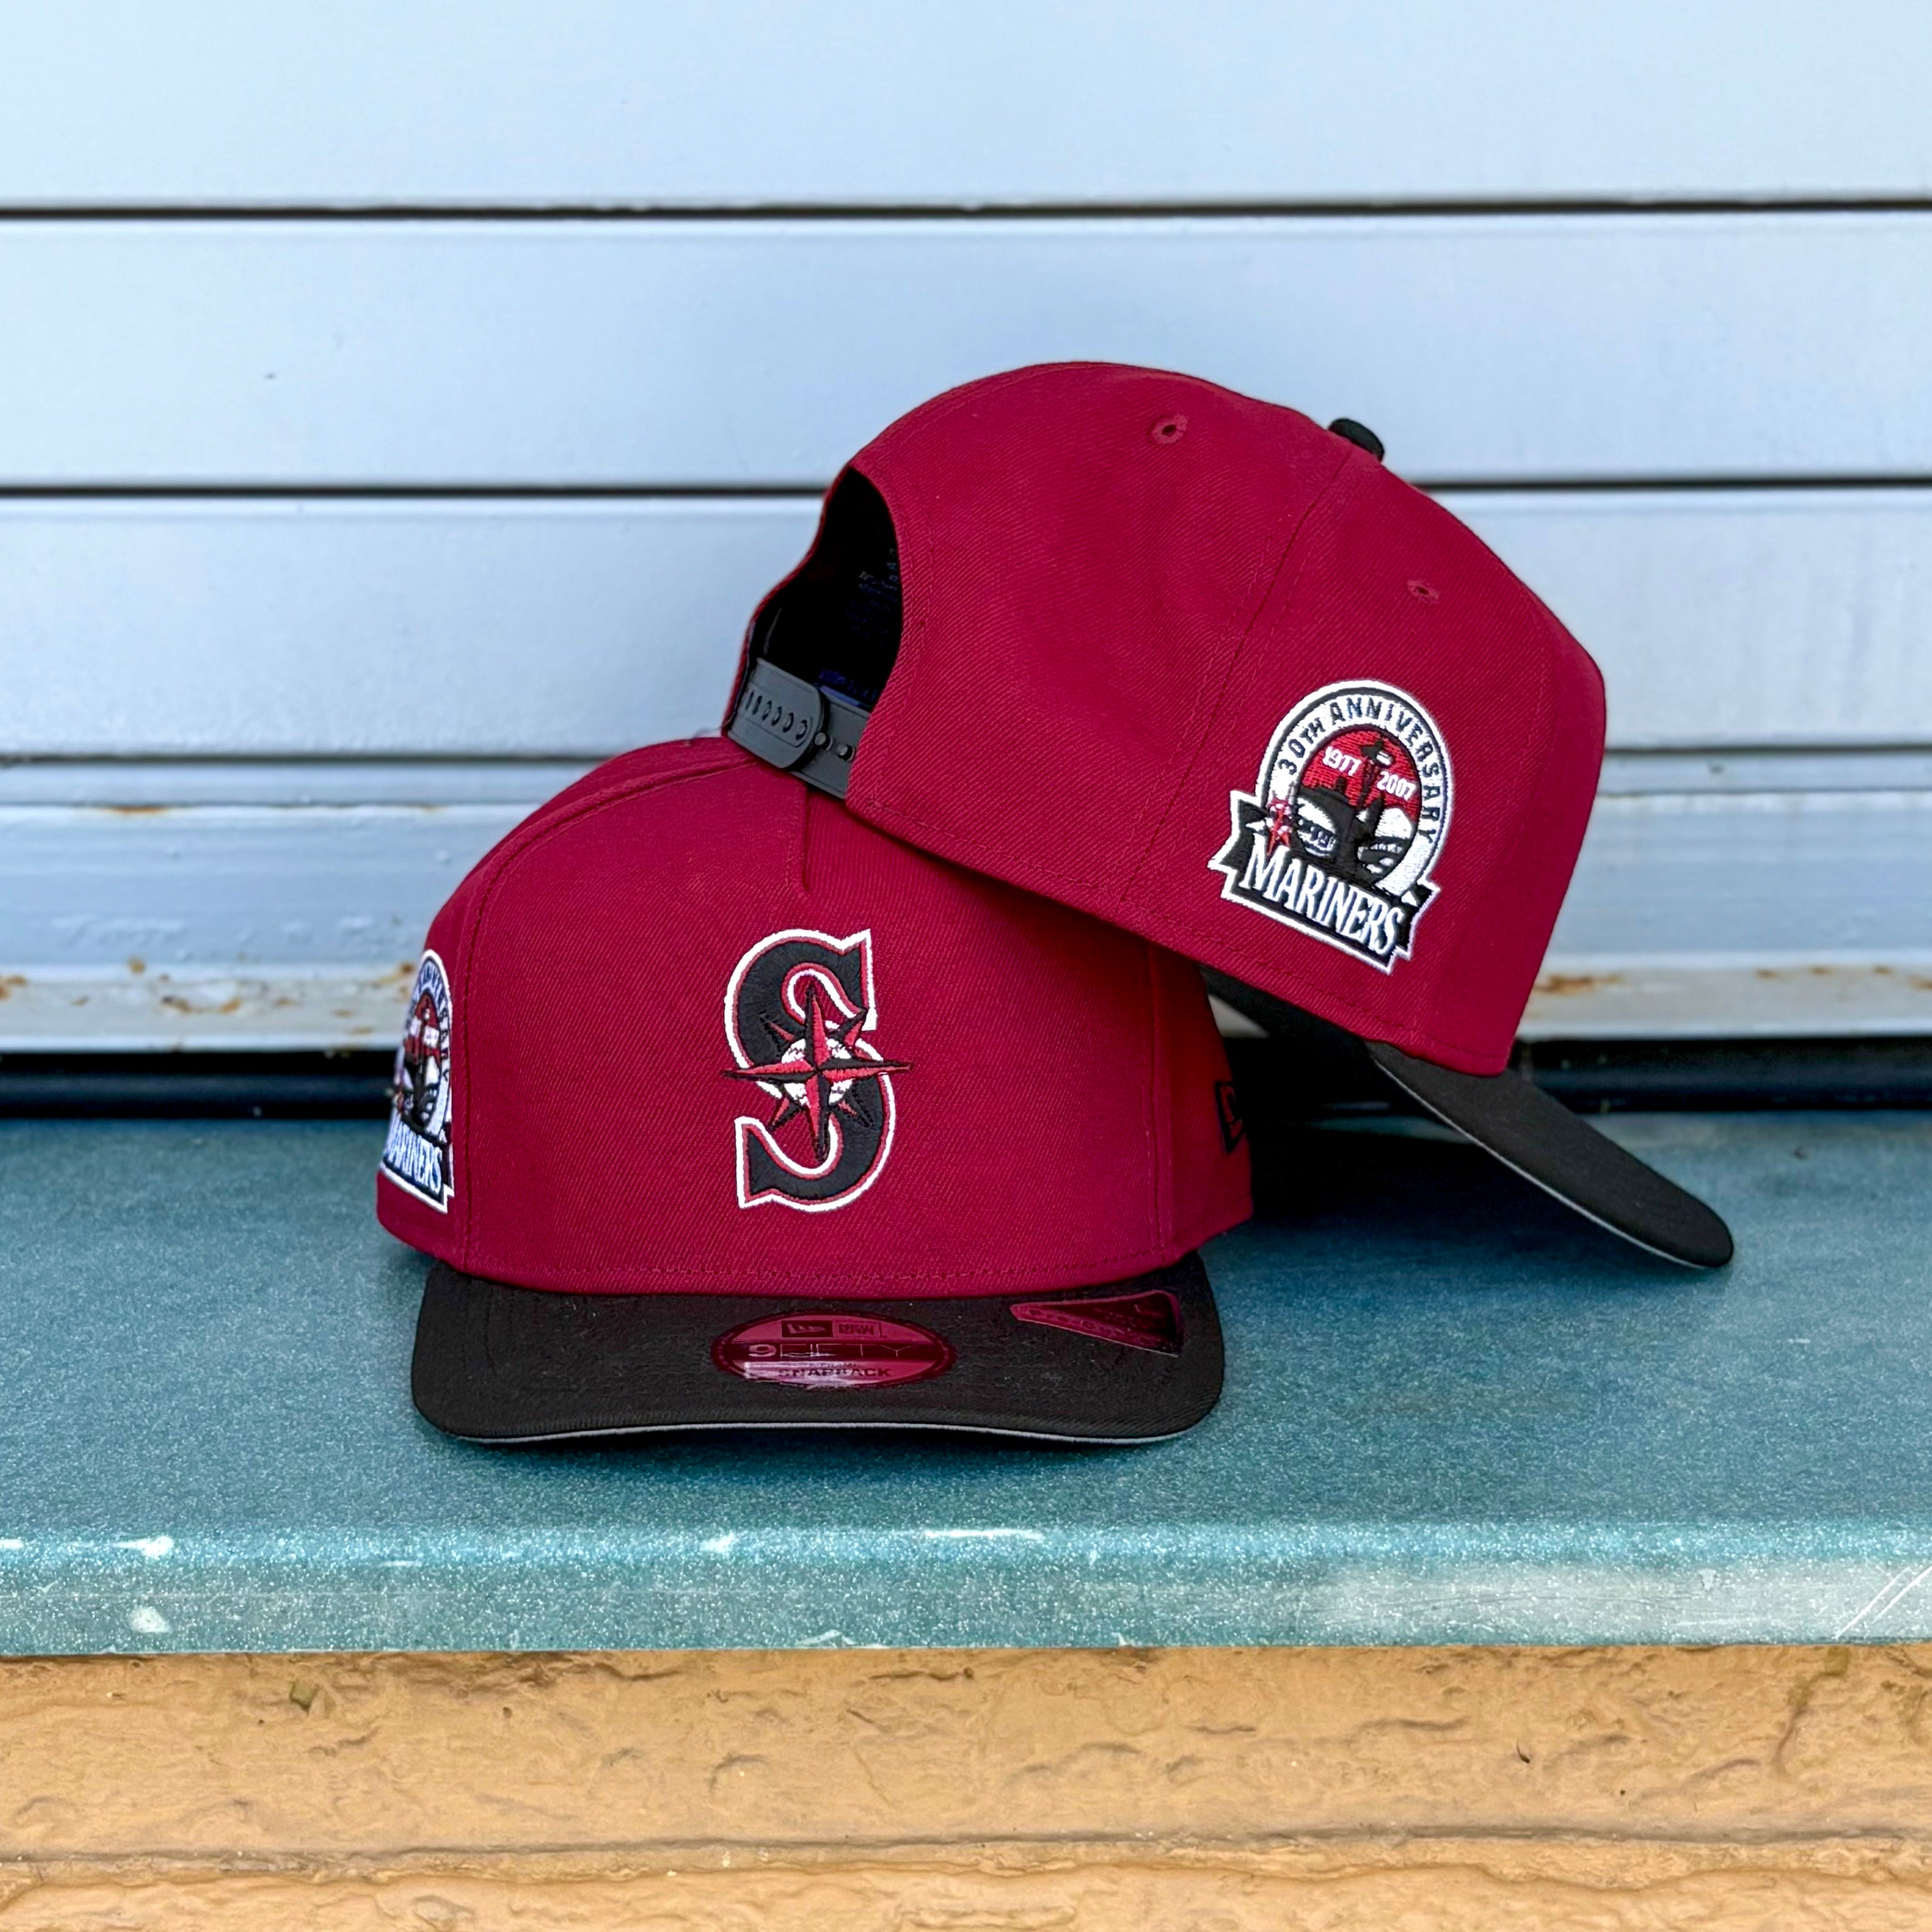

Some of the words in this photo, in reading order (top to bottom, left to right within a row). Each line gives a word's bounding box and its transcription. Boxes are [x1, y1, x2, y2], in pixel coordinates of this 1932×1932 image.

[1278, 717, 1326, 776] 30TH
[1329, 697, 1441, 844] ANNIVERSARY
[1321, 746, 1362, 776] 1977
[1376, 771, 1417, 801] 2007
[1238, 832, 1407, 955] MARINERS
[724, 928, 896, 1213] S
